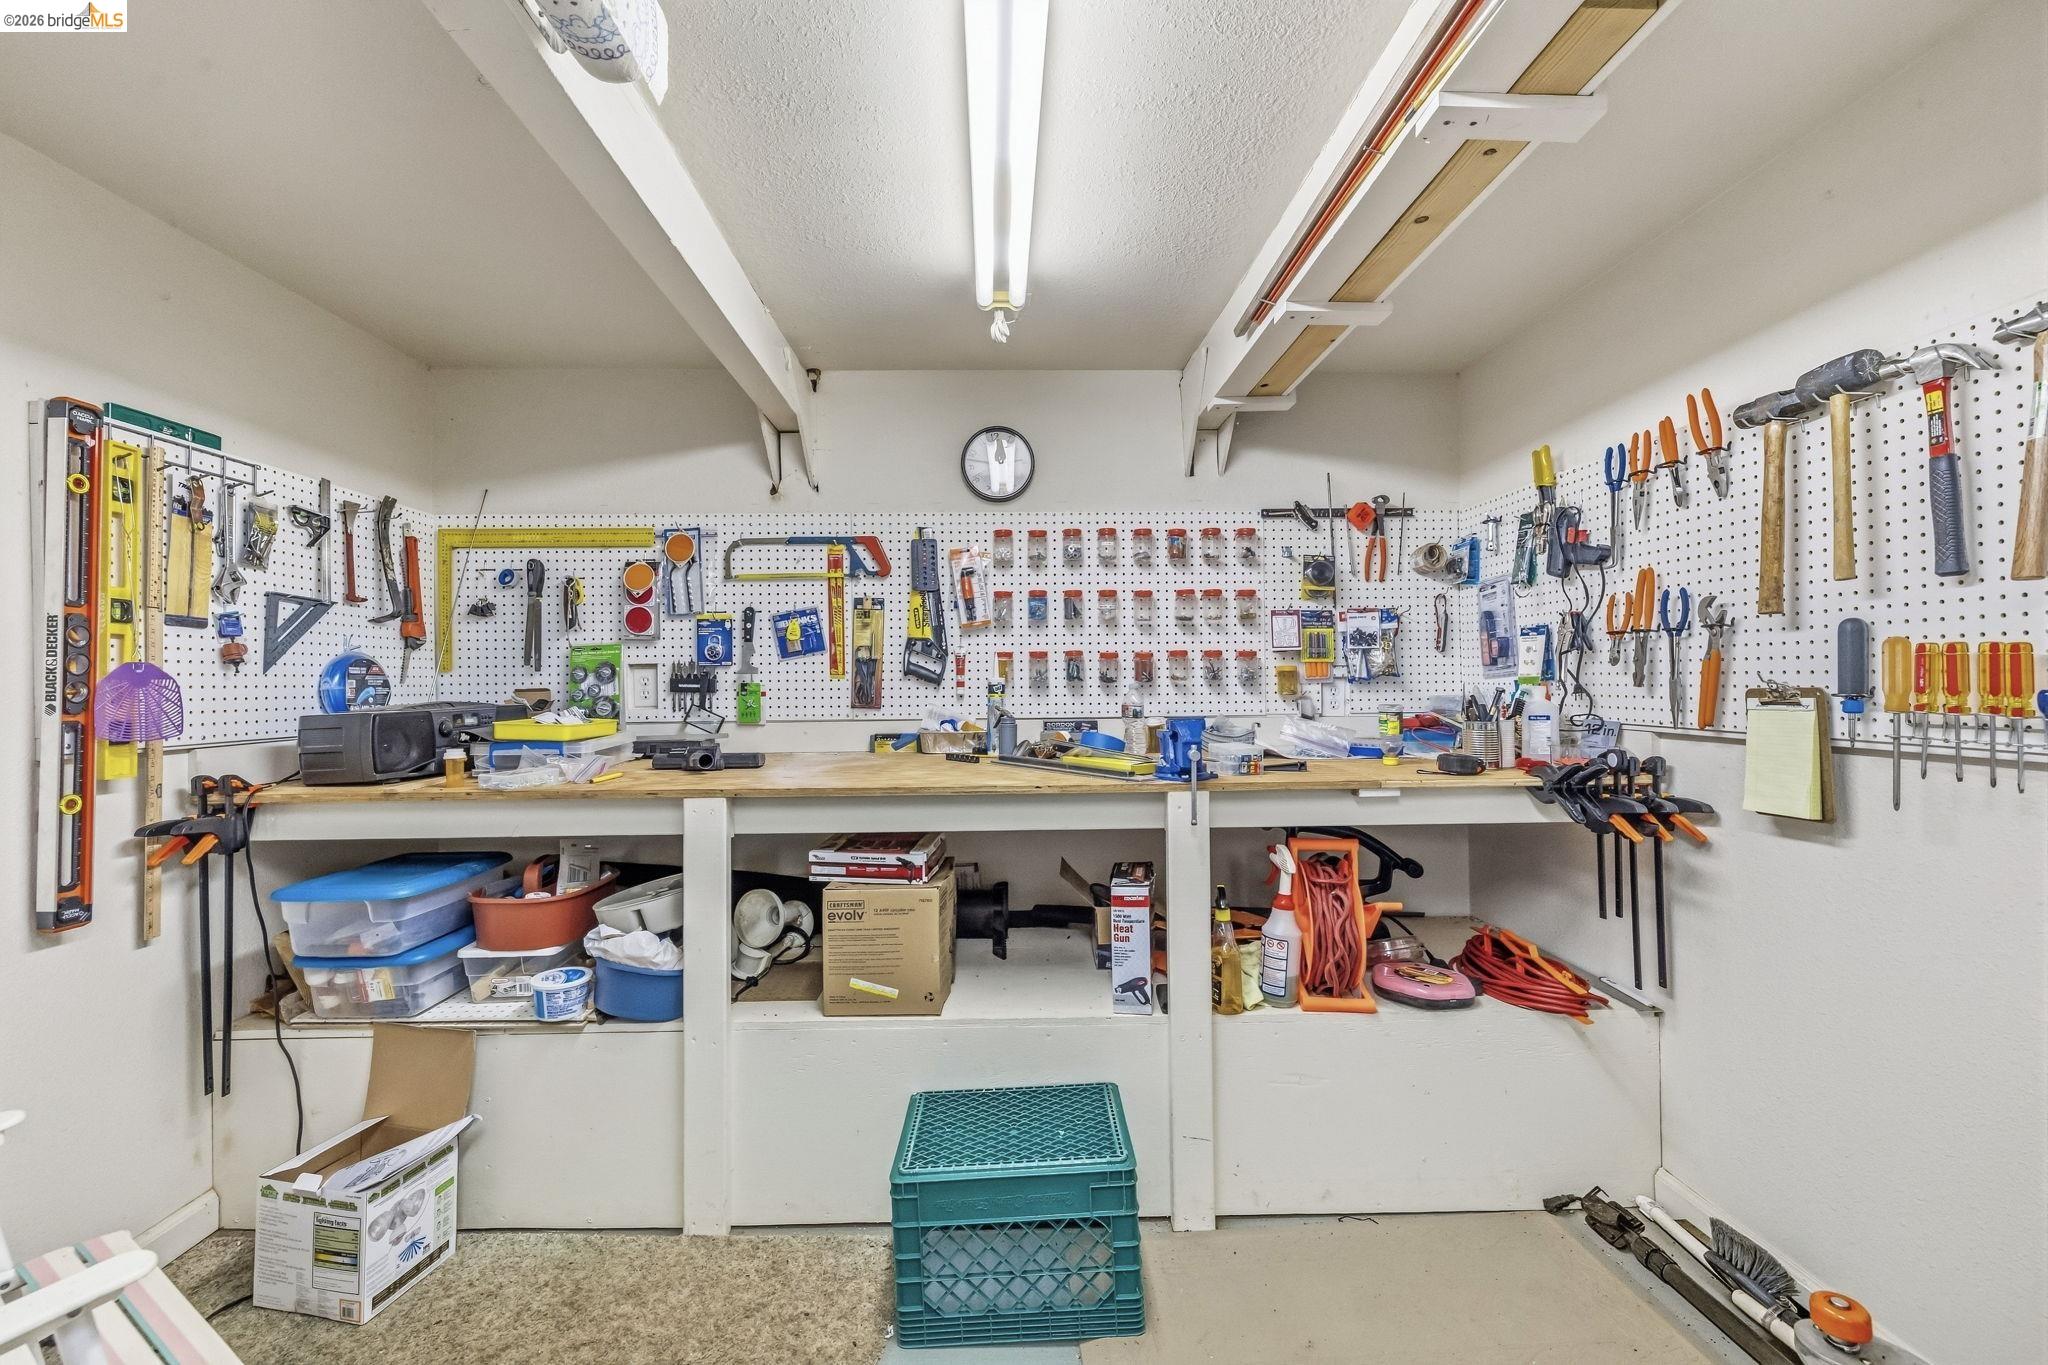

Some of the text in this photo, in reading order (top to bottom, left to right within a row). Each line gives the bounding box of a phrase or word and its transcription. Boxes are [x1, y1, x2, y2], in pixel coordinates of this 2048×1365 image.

[44, 614, 59, 702] BLACK&DECKER
[1602, 724, 1617, 737] in.
[827, 909, 864, 921] evolv
[1113, 924, 1134, 933] Heat
[1113, 934, 1130, 943] Gun
